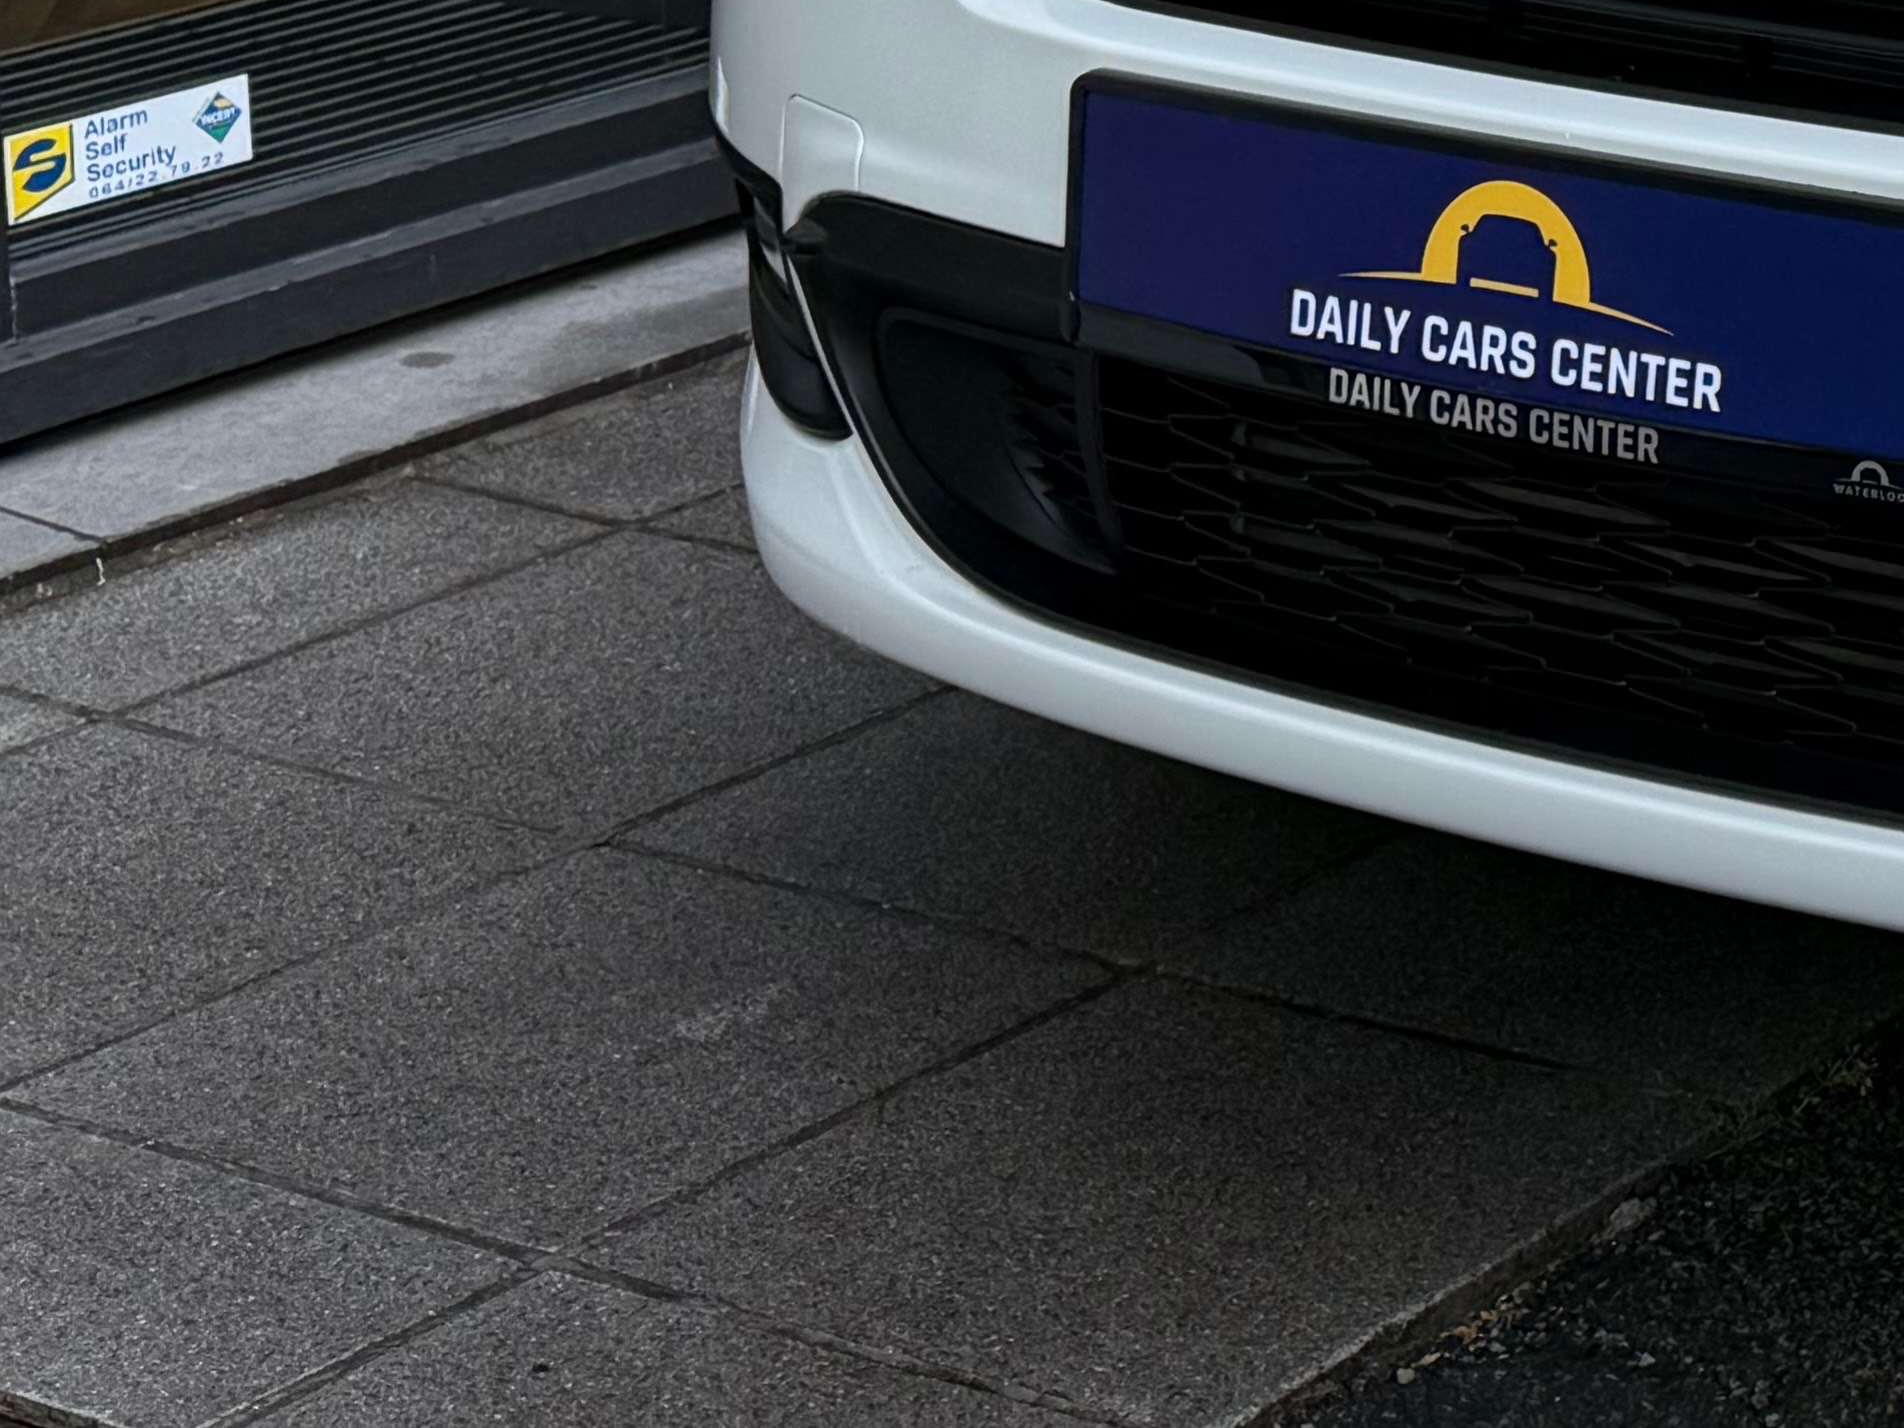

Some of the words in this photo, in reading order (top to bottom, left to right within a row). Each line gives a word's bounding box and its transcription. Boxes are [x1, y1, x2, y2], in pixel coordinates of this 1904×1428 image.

[85, 109, 148, 139] Alarm
[86, 132, 128, 161] Self
[87, 145, 176, 182] Security
[1290, 289, 1411, 354] DAILY
[1421, 315, 1537, 379] CARS
[1550, 338, 1723, 413] CENTER
[1329, 367, 1421, 419] DAILY
[1430, 389, 1518, 439] CARS
[1529, 407, 1660, 465] CENTER
